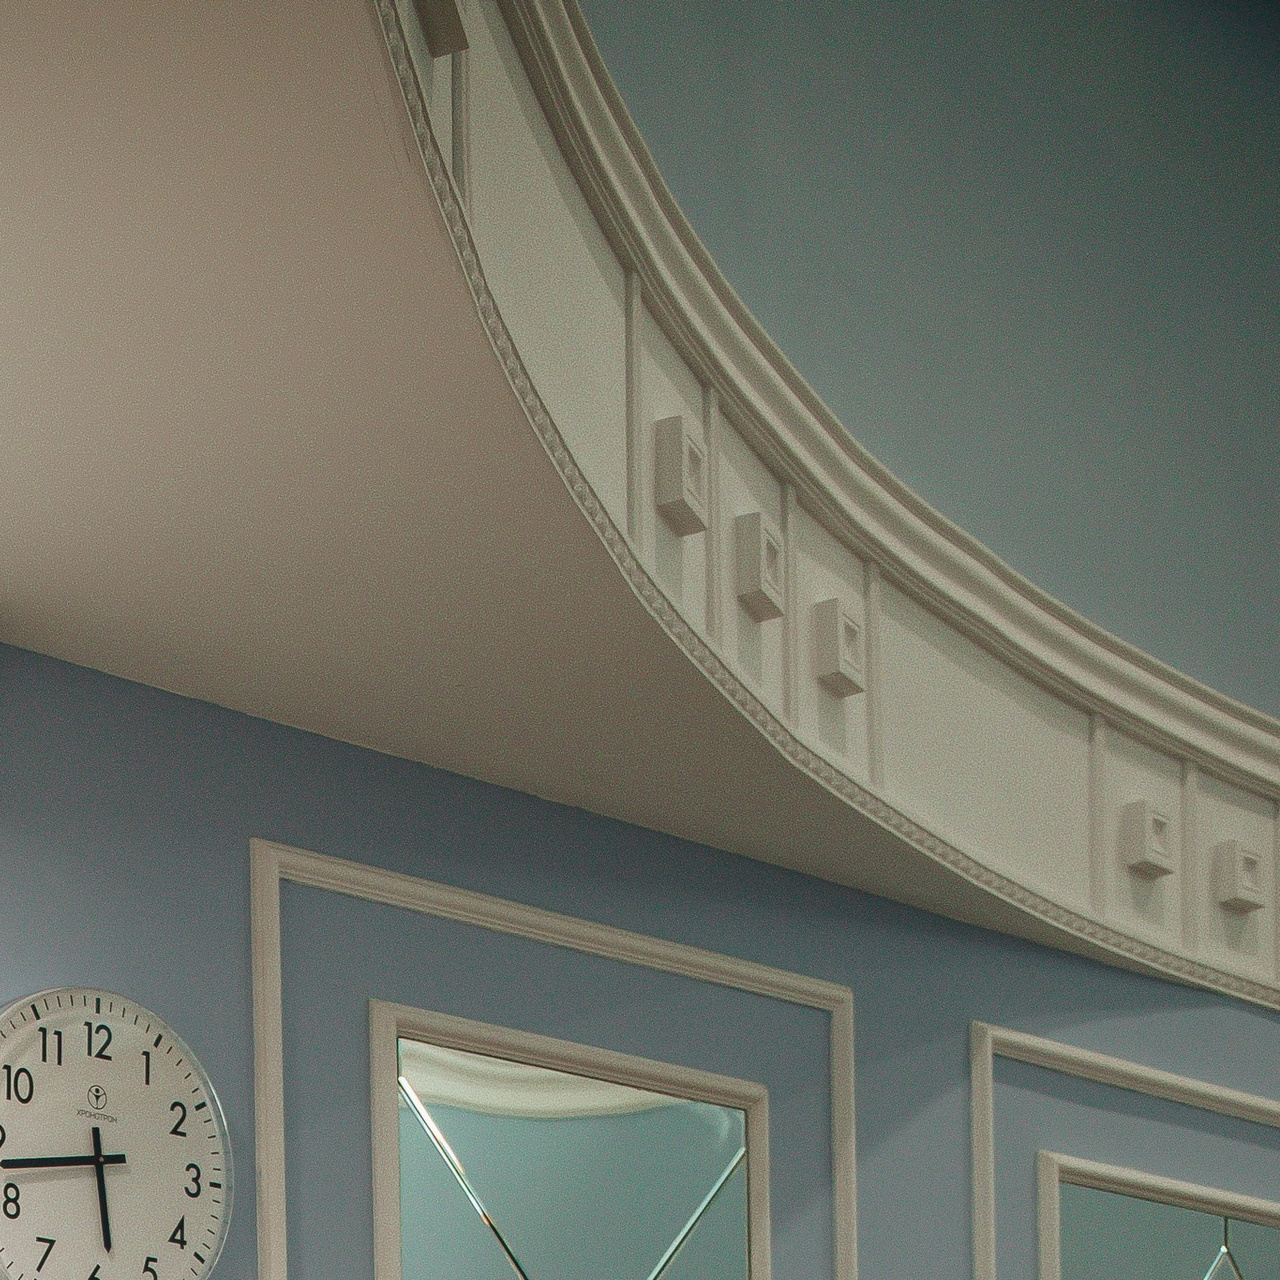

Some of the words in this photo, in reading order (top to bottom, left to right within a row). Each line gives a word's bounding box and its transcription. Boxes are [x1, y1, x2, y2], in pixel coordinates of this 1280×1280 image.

[38, 1026, 63, 1067] 11
[84, 1022, 113, 1061] 12
[2, 1064, 34, 1104] 10
[141, 1051, 151, 1086] 1
[169, 1101, 187, 1138] 2
[184, 1163, 202, 1198] 3
[2, 1182, 21, 1219] 8
[168, 1214, 188, 1250] 4
[36, 1236, 56, 1273] 7
